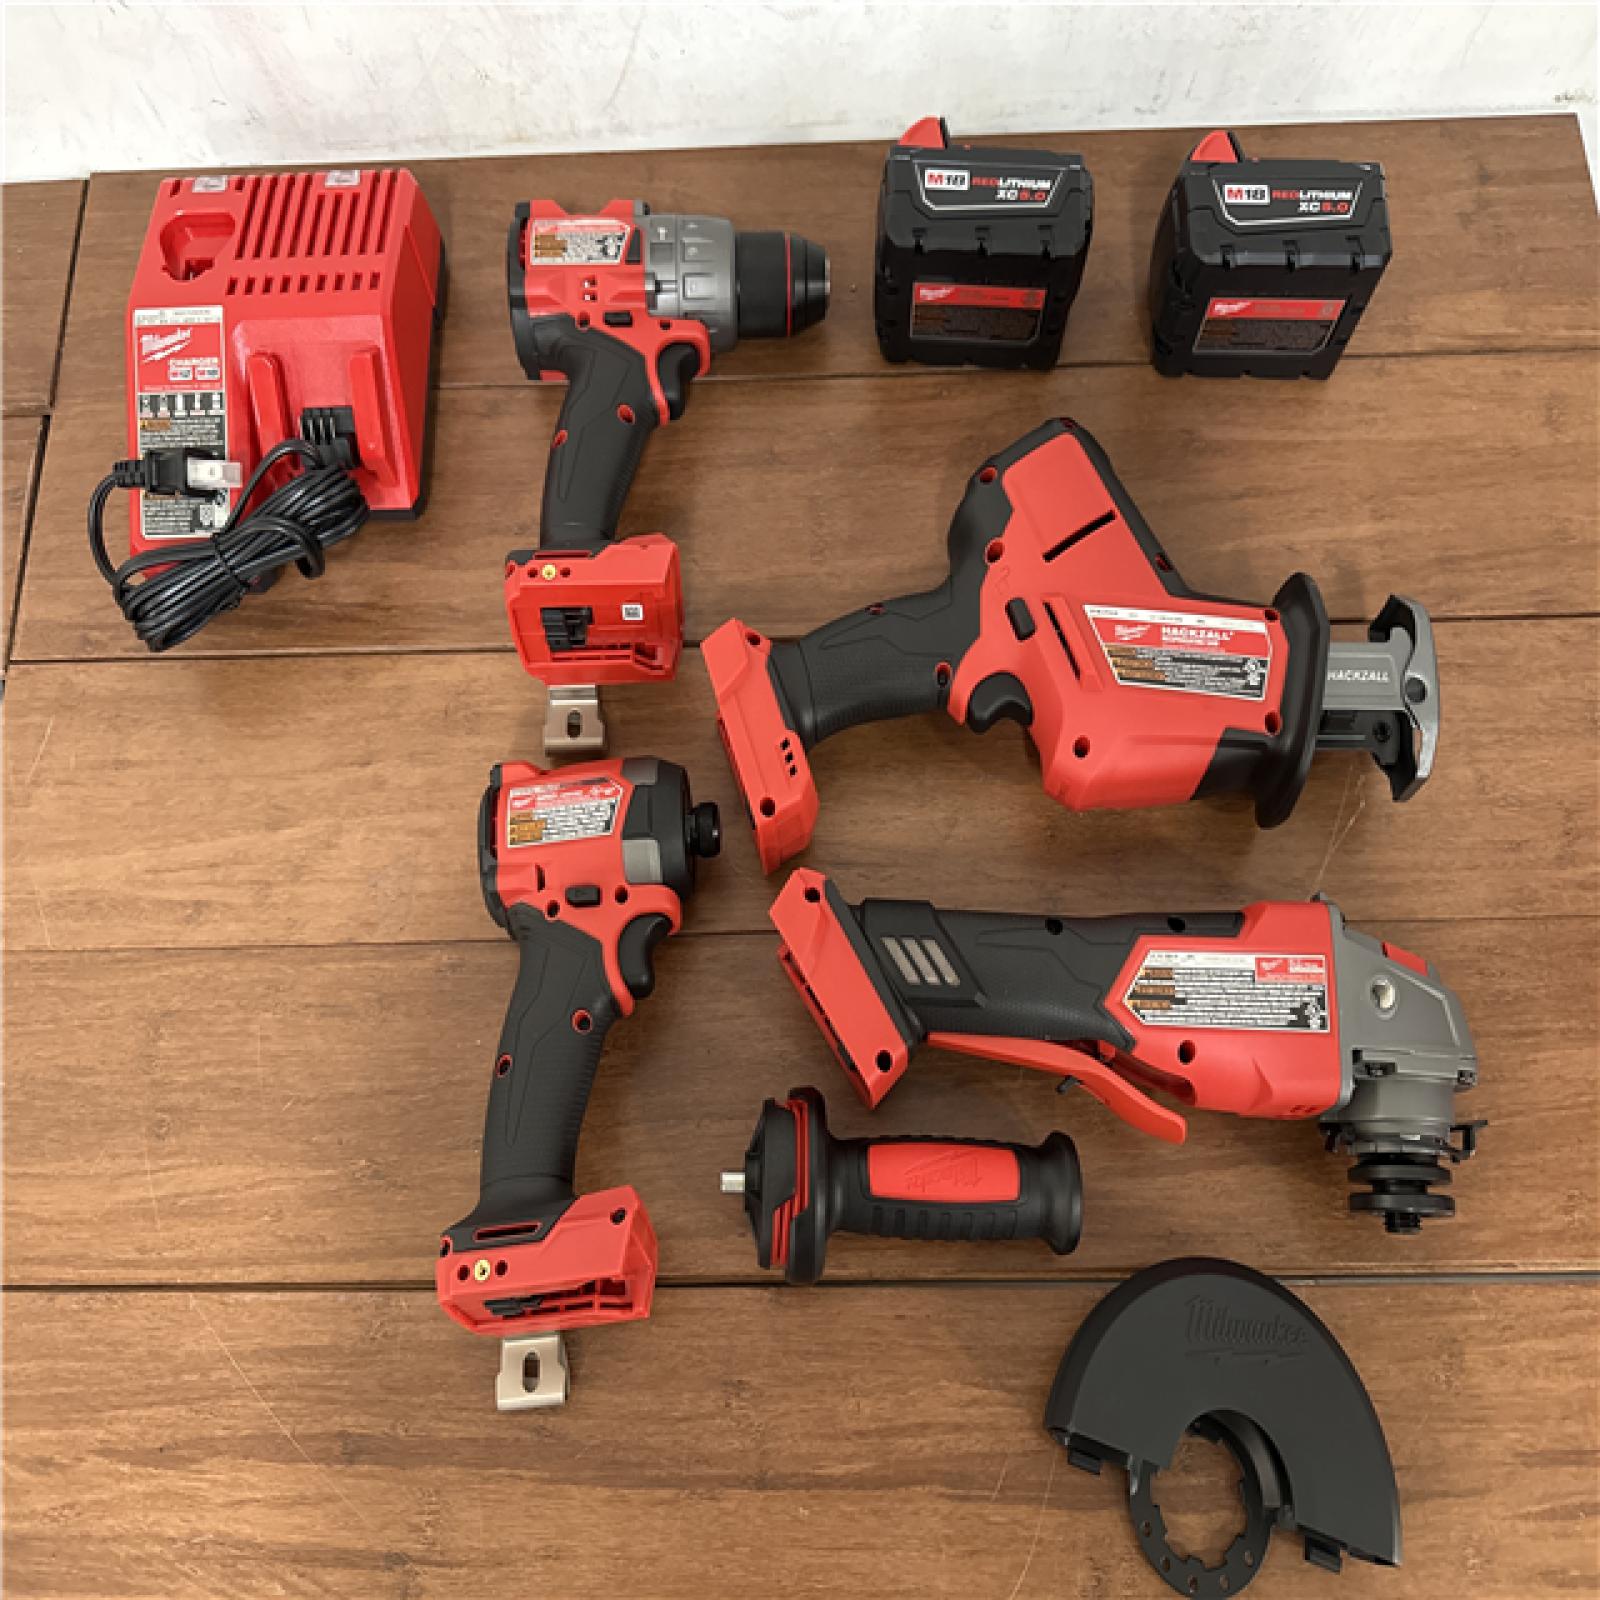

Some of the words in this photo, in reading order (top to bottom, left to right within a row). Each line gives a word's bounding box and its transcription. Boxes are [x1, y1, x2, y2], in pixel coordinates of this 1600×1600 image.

[927, 172, 966, 186] M18
[1227, 187, 1266, 201] M18
[1327, 669, 1390, 682] HACKZALL
[1184, 1295, 1309, 1345] Milwaukee
